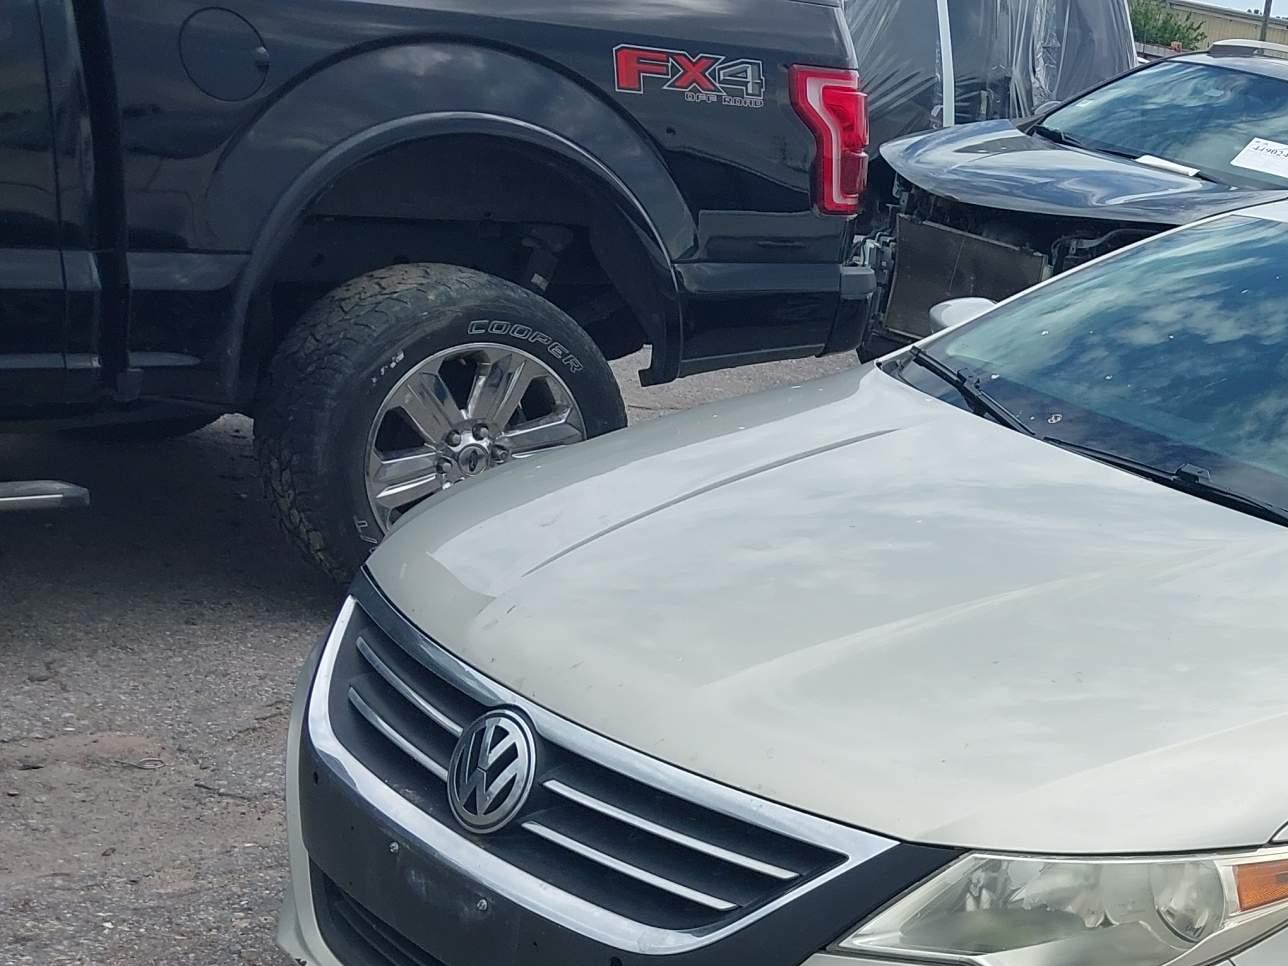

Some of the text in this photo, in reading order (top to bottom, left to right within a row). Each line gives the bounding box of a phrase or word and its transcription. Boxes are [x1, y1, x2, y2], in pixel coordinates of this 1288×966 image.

[612, 43, 766, 100] FX4
[684, 92, 764, 108] OFF ROAD
[467, 320, 584, 374] COOPER
